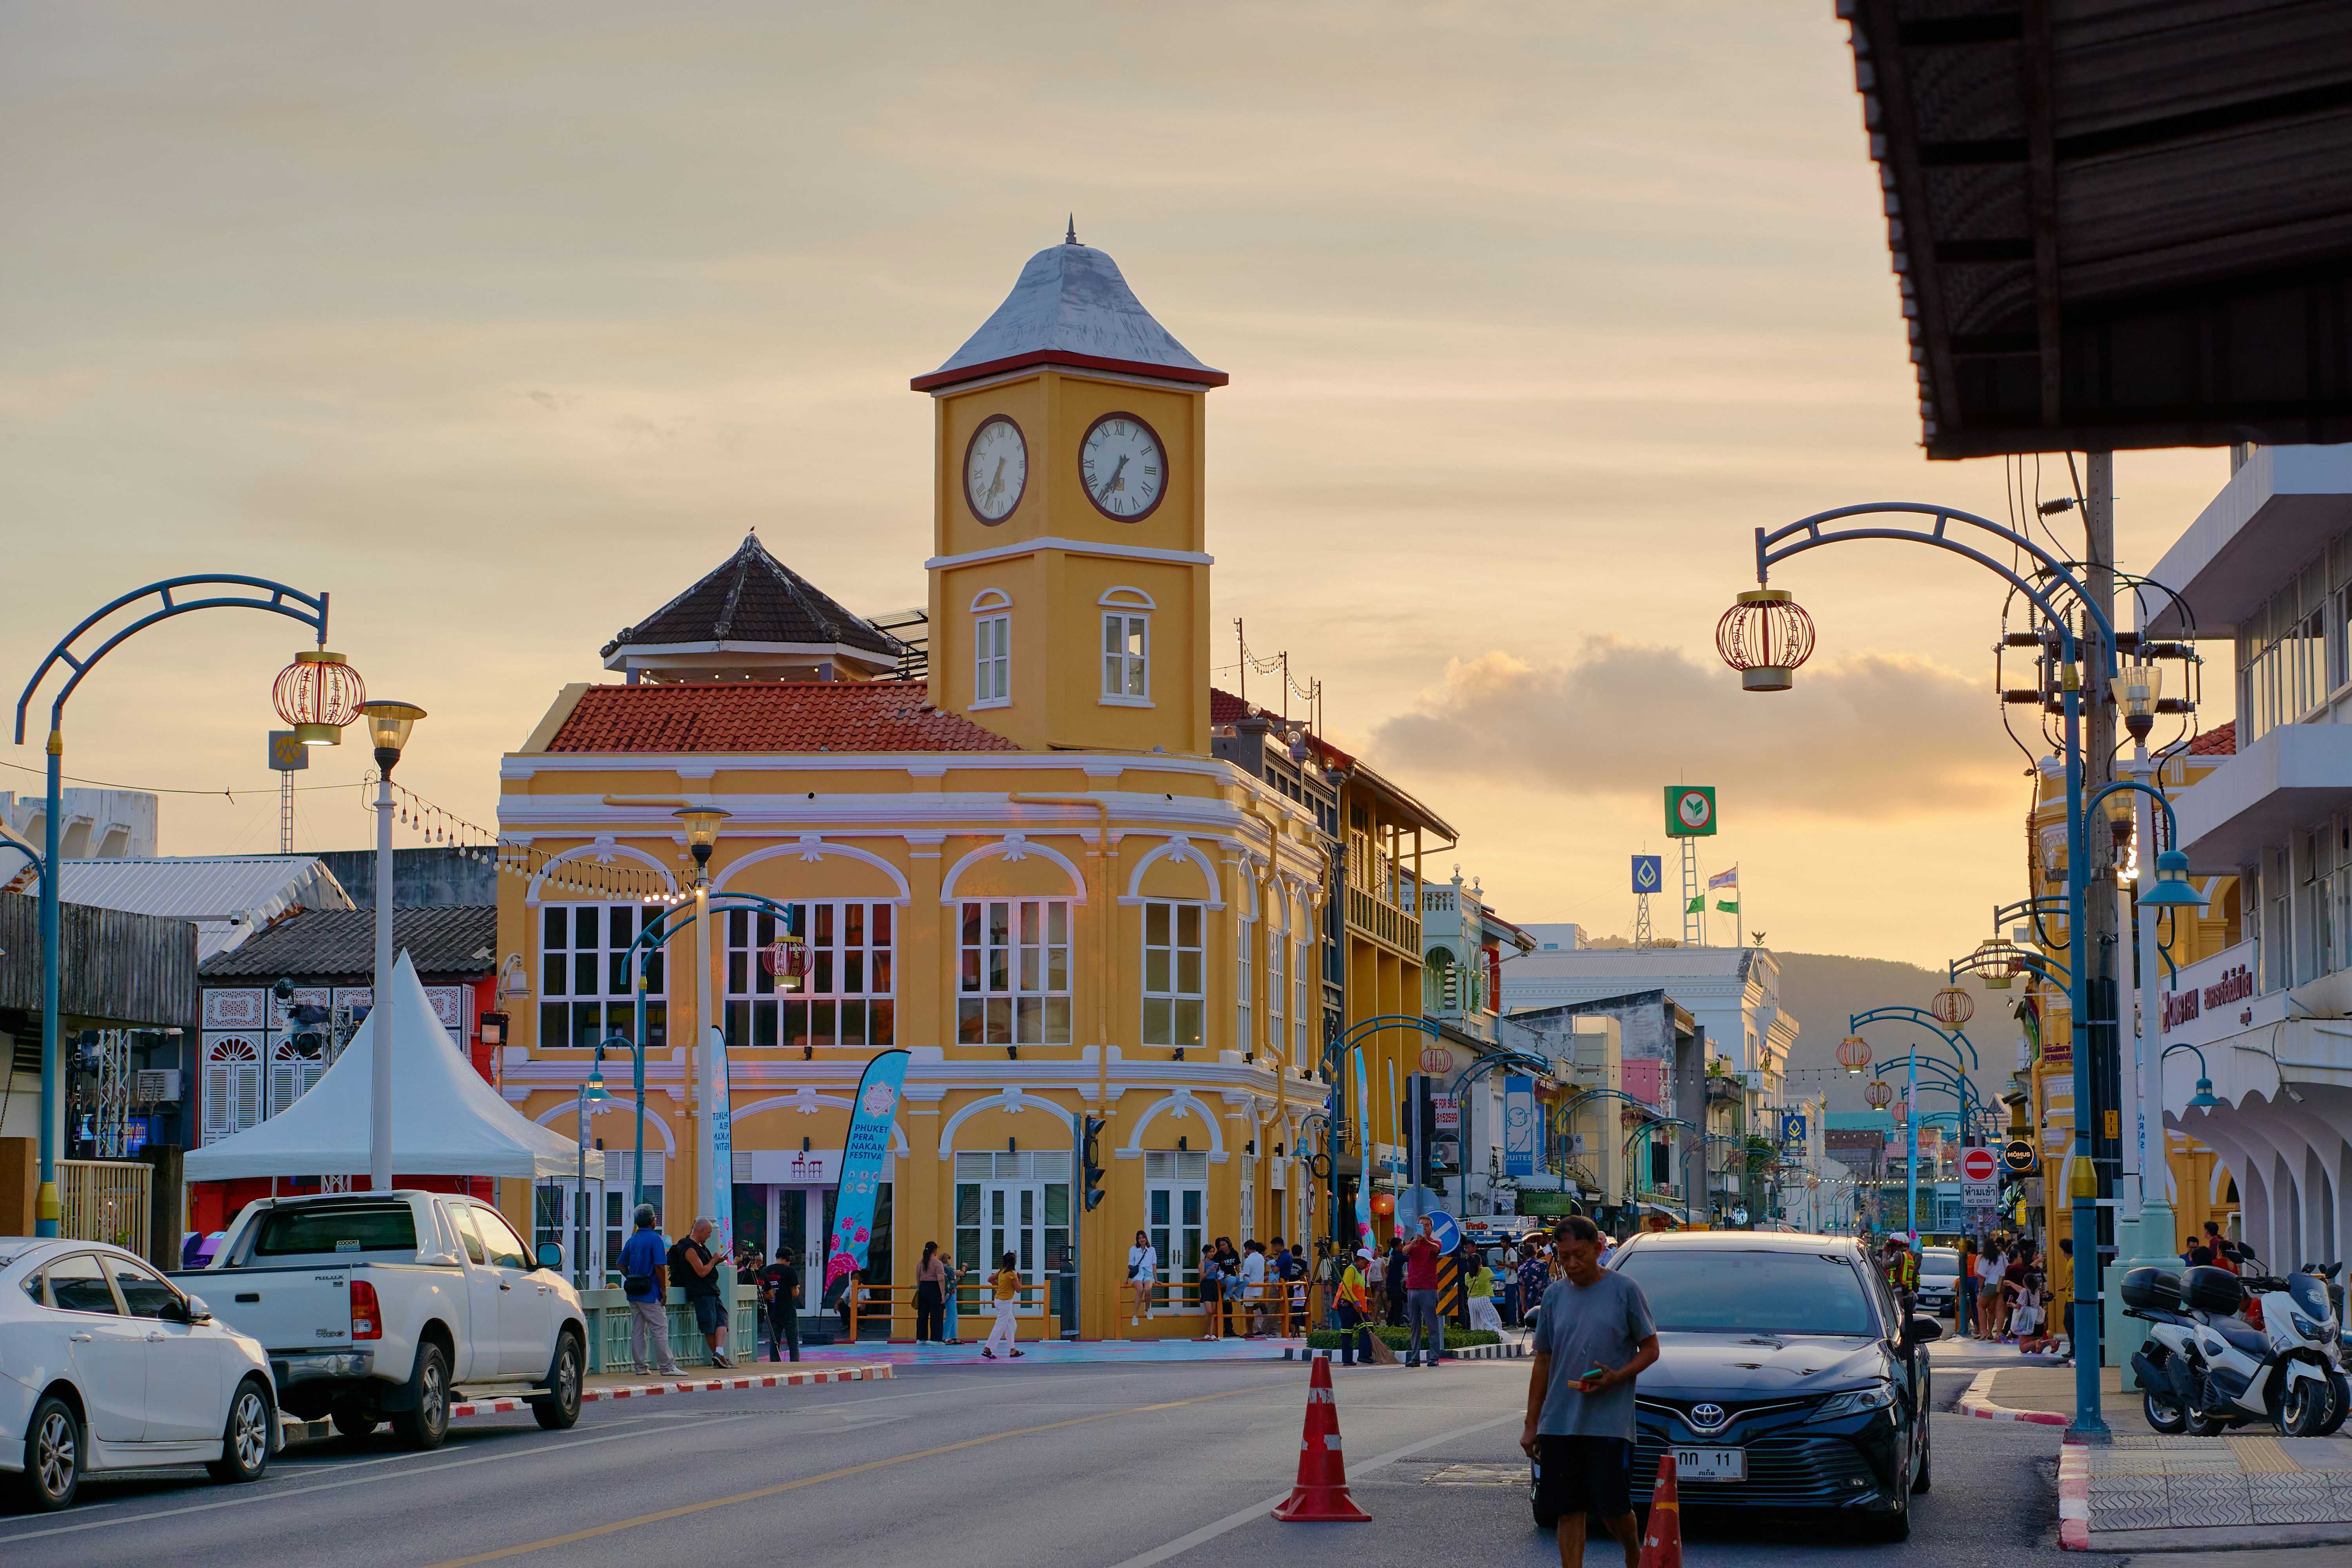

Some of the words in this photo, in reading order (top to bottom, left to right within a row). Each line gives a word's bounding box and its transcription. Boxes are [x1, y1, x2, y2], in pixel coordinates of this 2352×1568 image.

[1098, 423, 1111, 439] XI
[1114, 421, 1125, 436] XII
[985, 431, 994, 447] XI
[1086, 438, 1099, 452] X
[976, 449, 985, 460] X
[1140, 445, 1152, 457] II
[1083, 458, 1094, 469] IX
[1144, 465, 1156, 476] III
[974, 468, 983, 480] IX
[1085, 473, 1099, 492] VIII
[1141, 481, 1153, 498] IV
[998, 500, 1005, 515] VI
[1114, 498, 1124, 513] VI
[1131, 495, 1141, 510] V
[855, 1124, 889, 1133] PHUKET
[851, 1142, 885, 1151] NAKAN
[1965, 1185, 1995, 1196] ห้ามเข้า
[2174, 1327, 2190, 1337] POLICE
[1679, 1452, 1698, 1465] กก
[1715, 1453, 1730, 1466] 11
